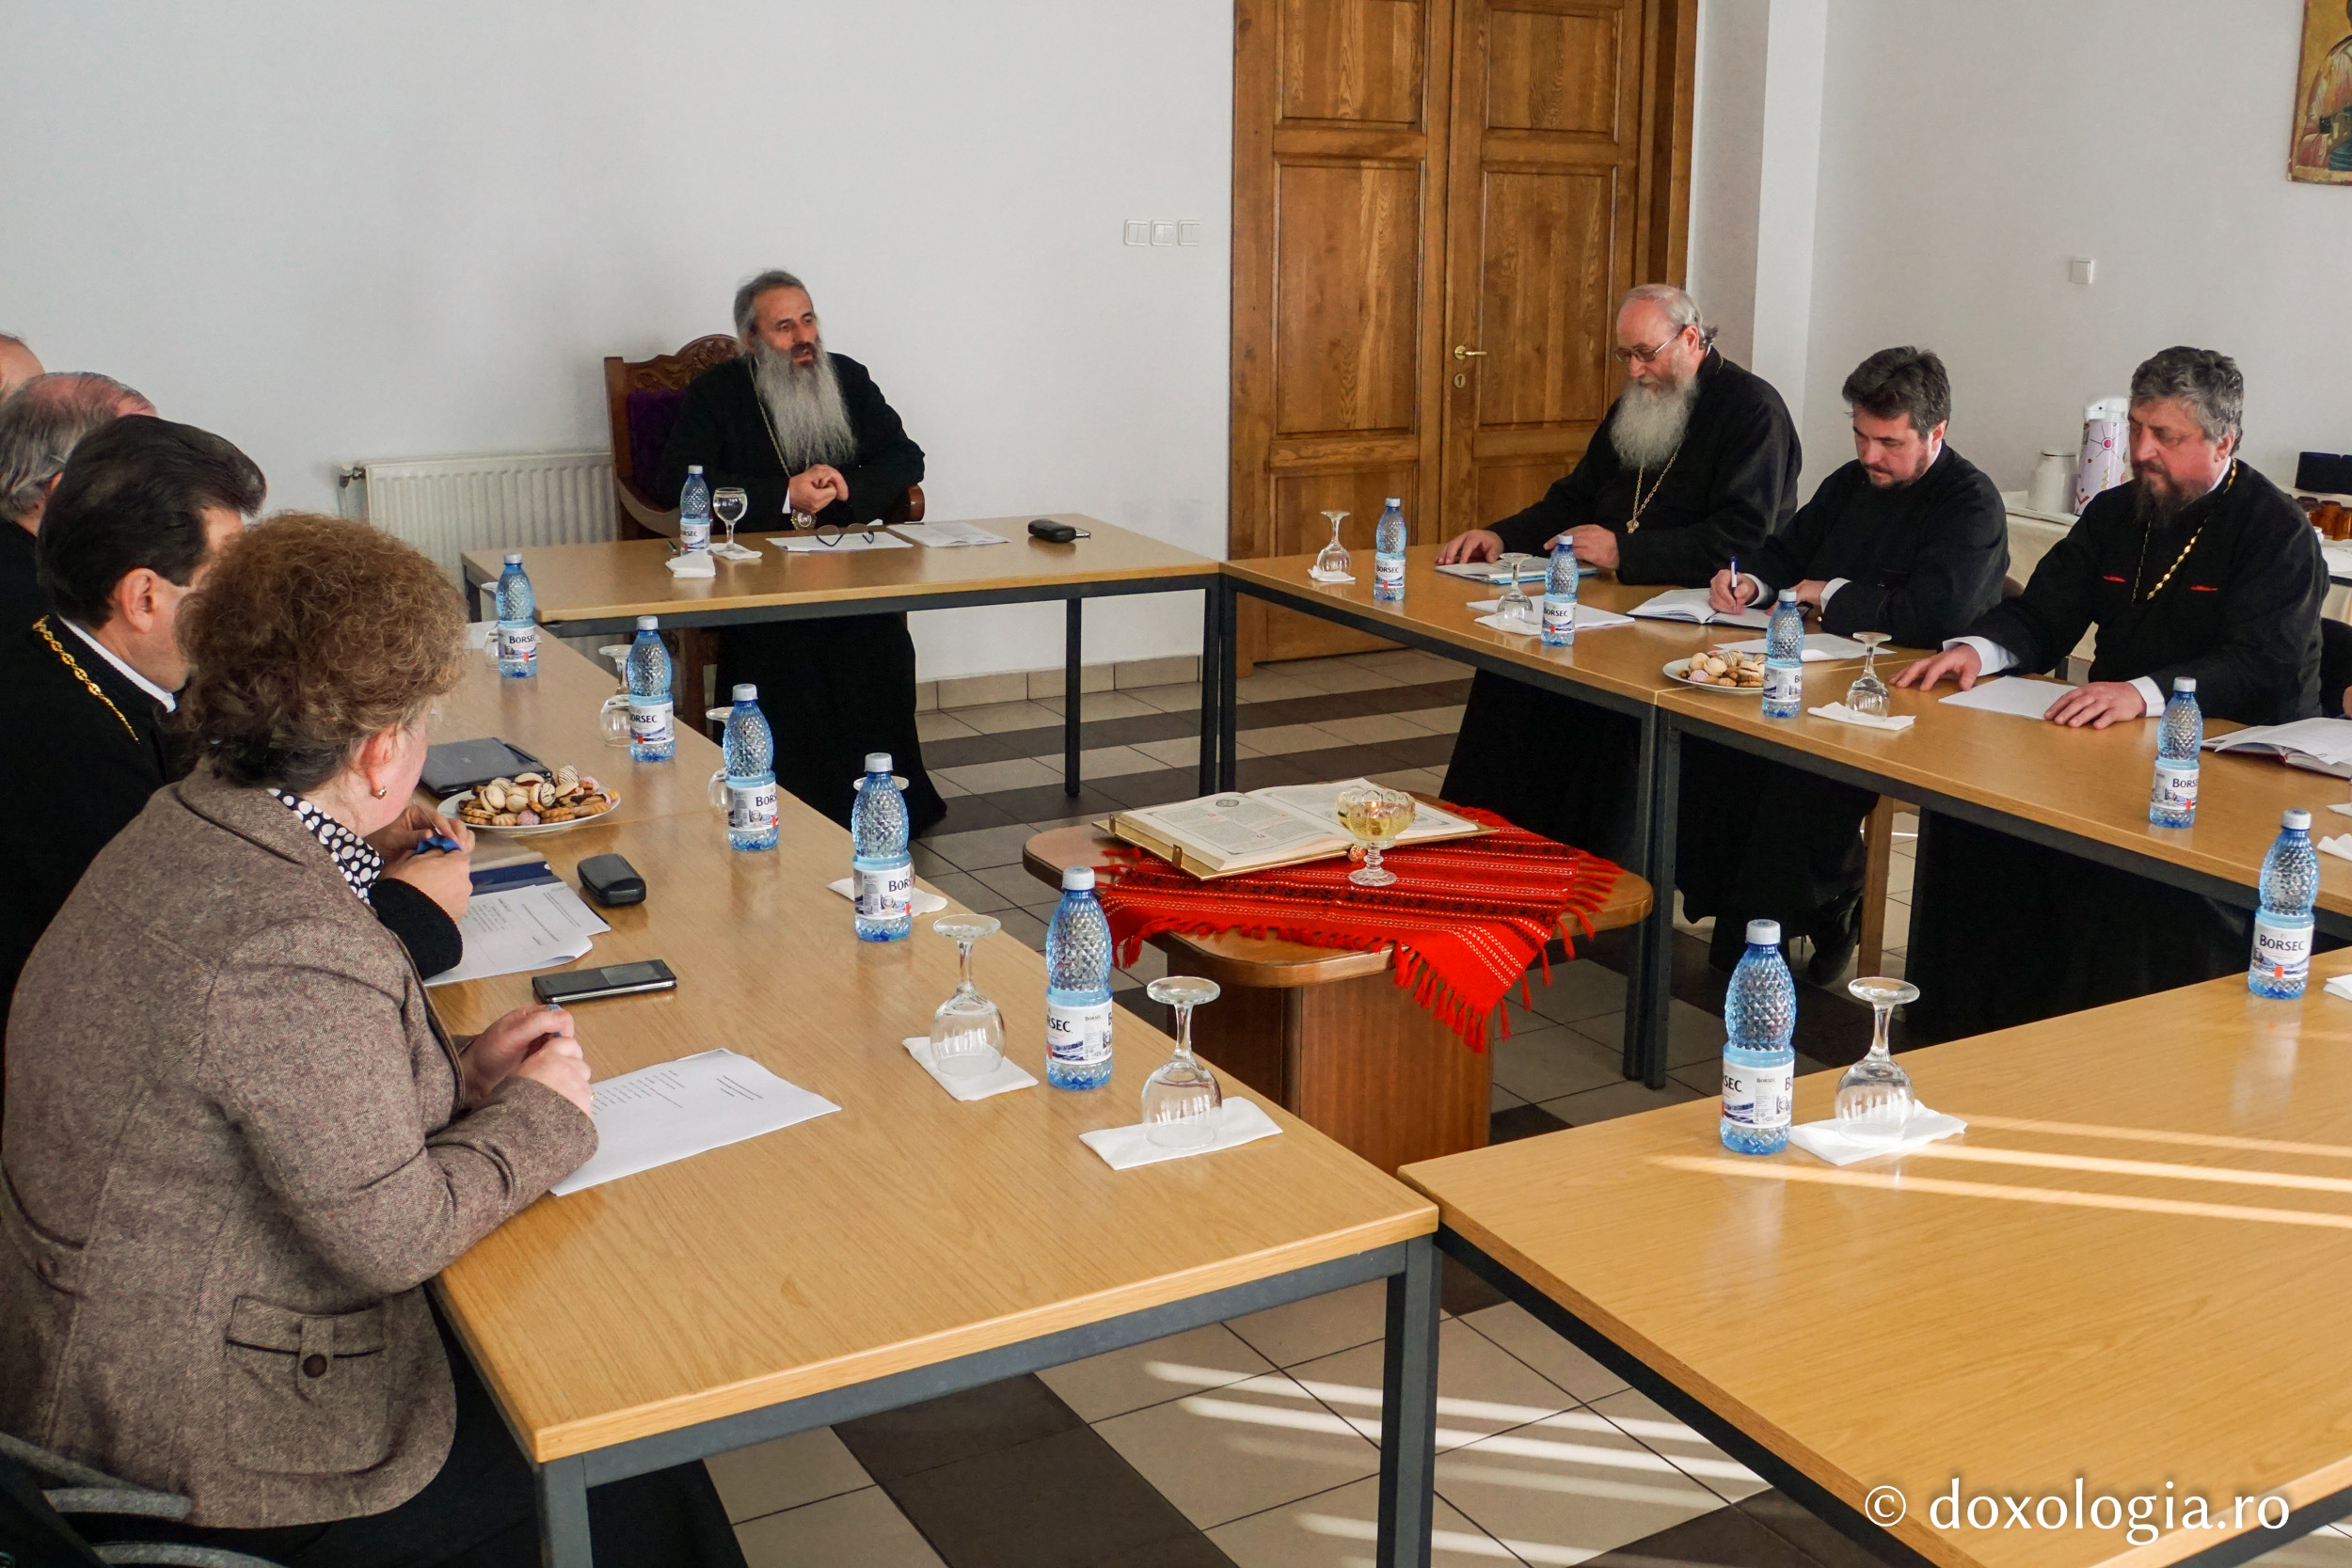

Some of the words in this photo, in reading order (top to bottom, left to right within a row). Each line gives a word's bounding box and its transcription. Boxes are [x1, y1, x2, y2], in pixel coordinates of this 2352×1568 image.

[1375, 565, 1400, 574] BORSEC
[1544, 607, 1568, 617] BORSEC
[2259, 933, 2305, 952] BORSEC
